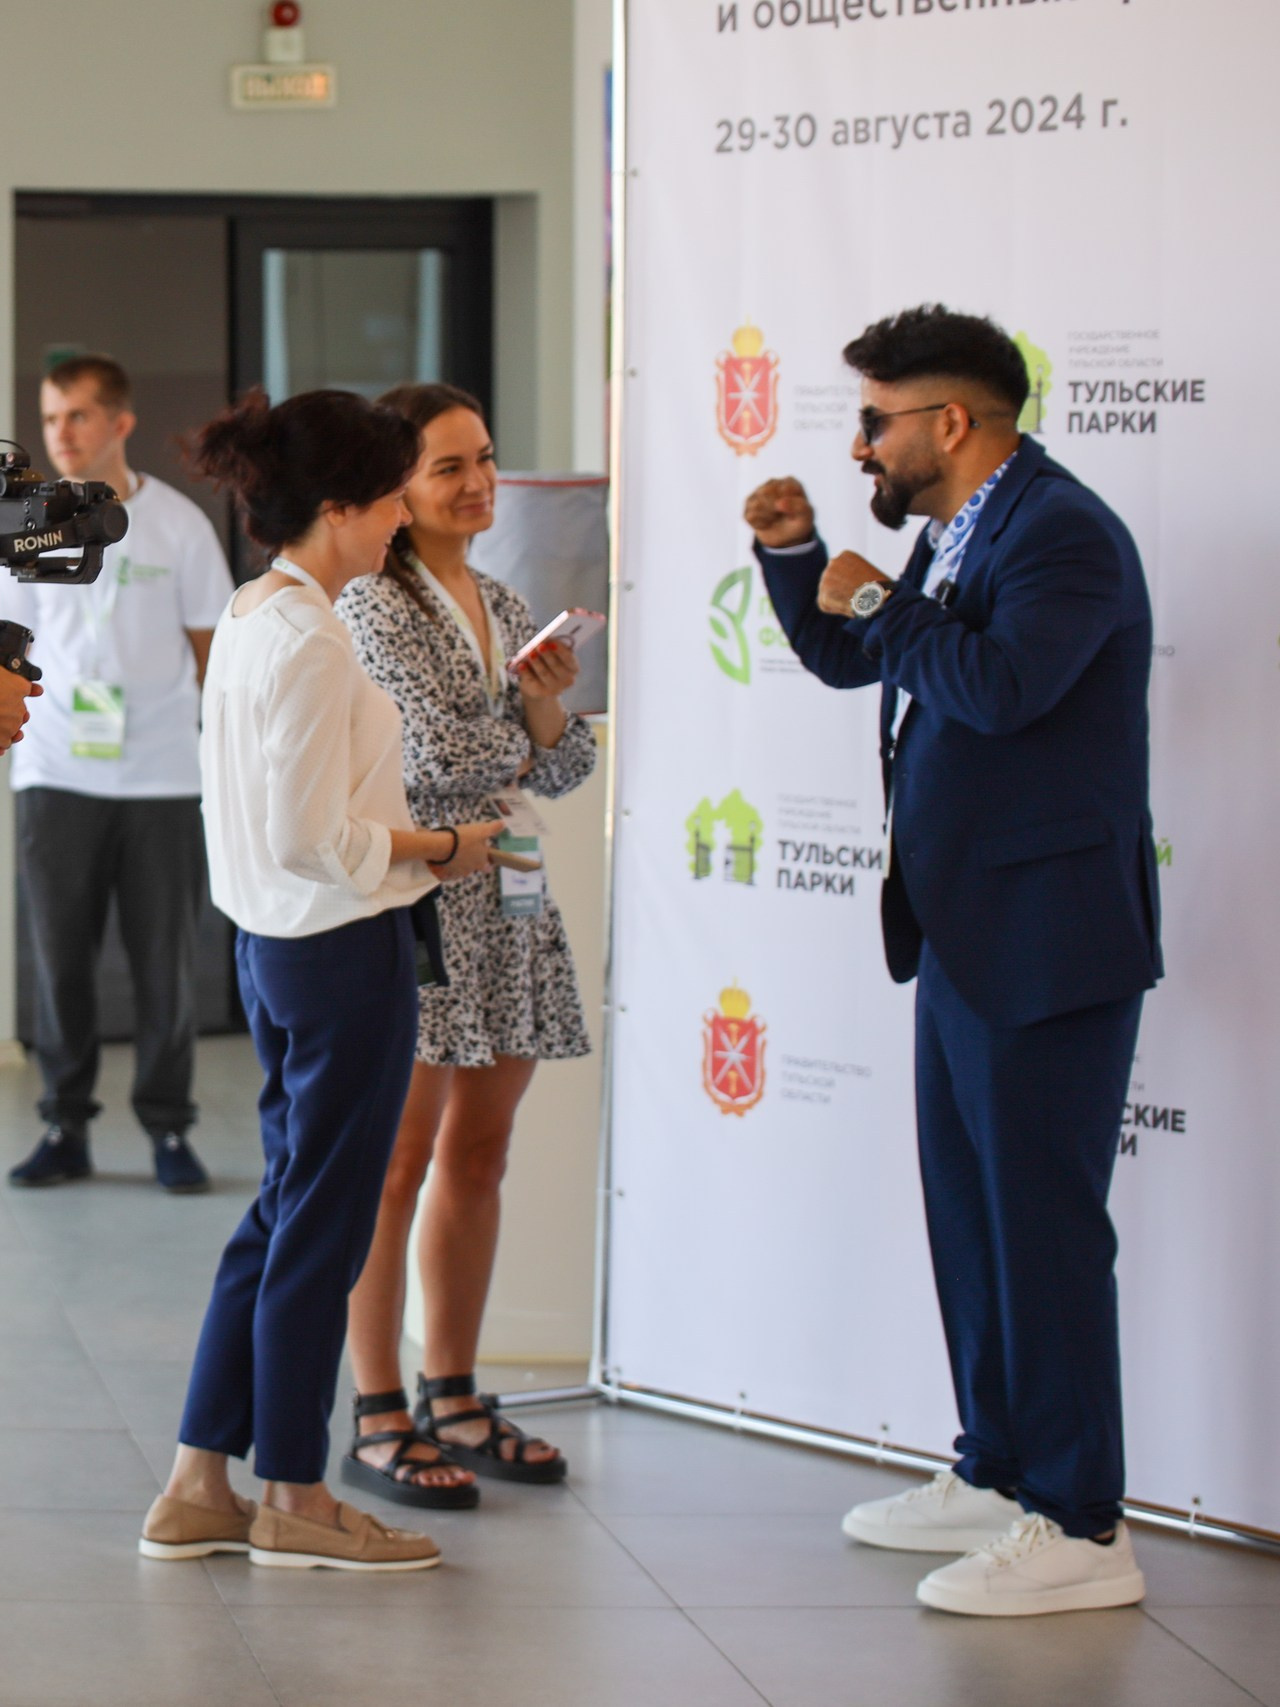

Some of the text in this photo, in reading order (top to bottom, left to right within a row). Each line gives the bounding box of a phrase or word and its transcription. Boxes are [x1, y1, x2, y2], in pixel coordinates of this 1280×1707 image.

[718, 0, 1070, 33] и общест
[715, 93, 1128, 153] 29-30 августа 2024 г.
[1068, 379, 1206, 403] ТУЛЬСКИЕ
[1068, 411, 1157, 434] ПАРКИ
[14, 530, 63, 552] RONIN
[778, 839, 883, 870] ТУЛЬСКИ
[777, 868, 855, 896] ПАРКИ
[1121, 1102, 1186, 1133] СКИЕ
